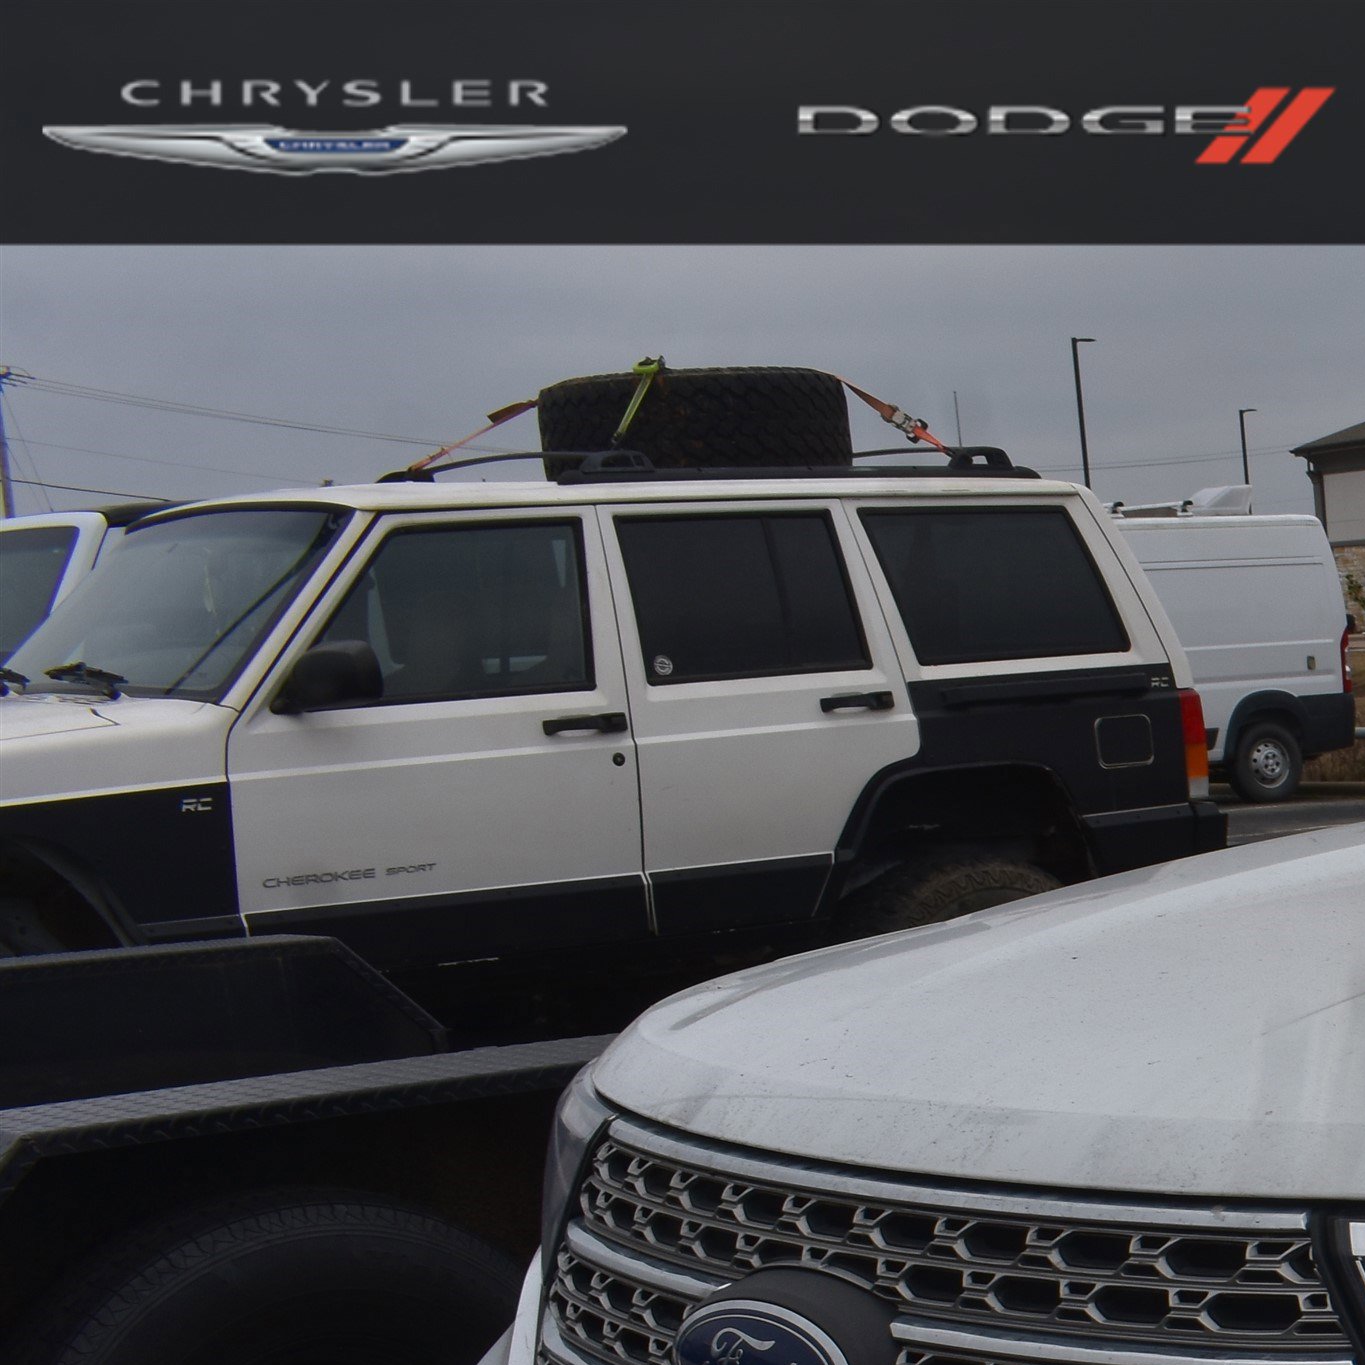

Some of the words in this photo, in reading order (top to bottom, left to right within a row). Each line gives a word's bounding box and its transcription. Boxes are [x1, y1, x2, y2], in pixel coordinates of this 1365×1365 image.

[181, 798, 212, 812] RC
[262, 868, 376, 889] CHEROKEE
[385, 863, 437, 877] SPORT
